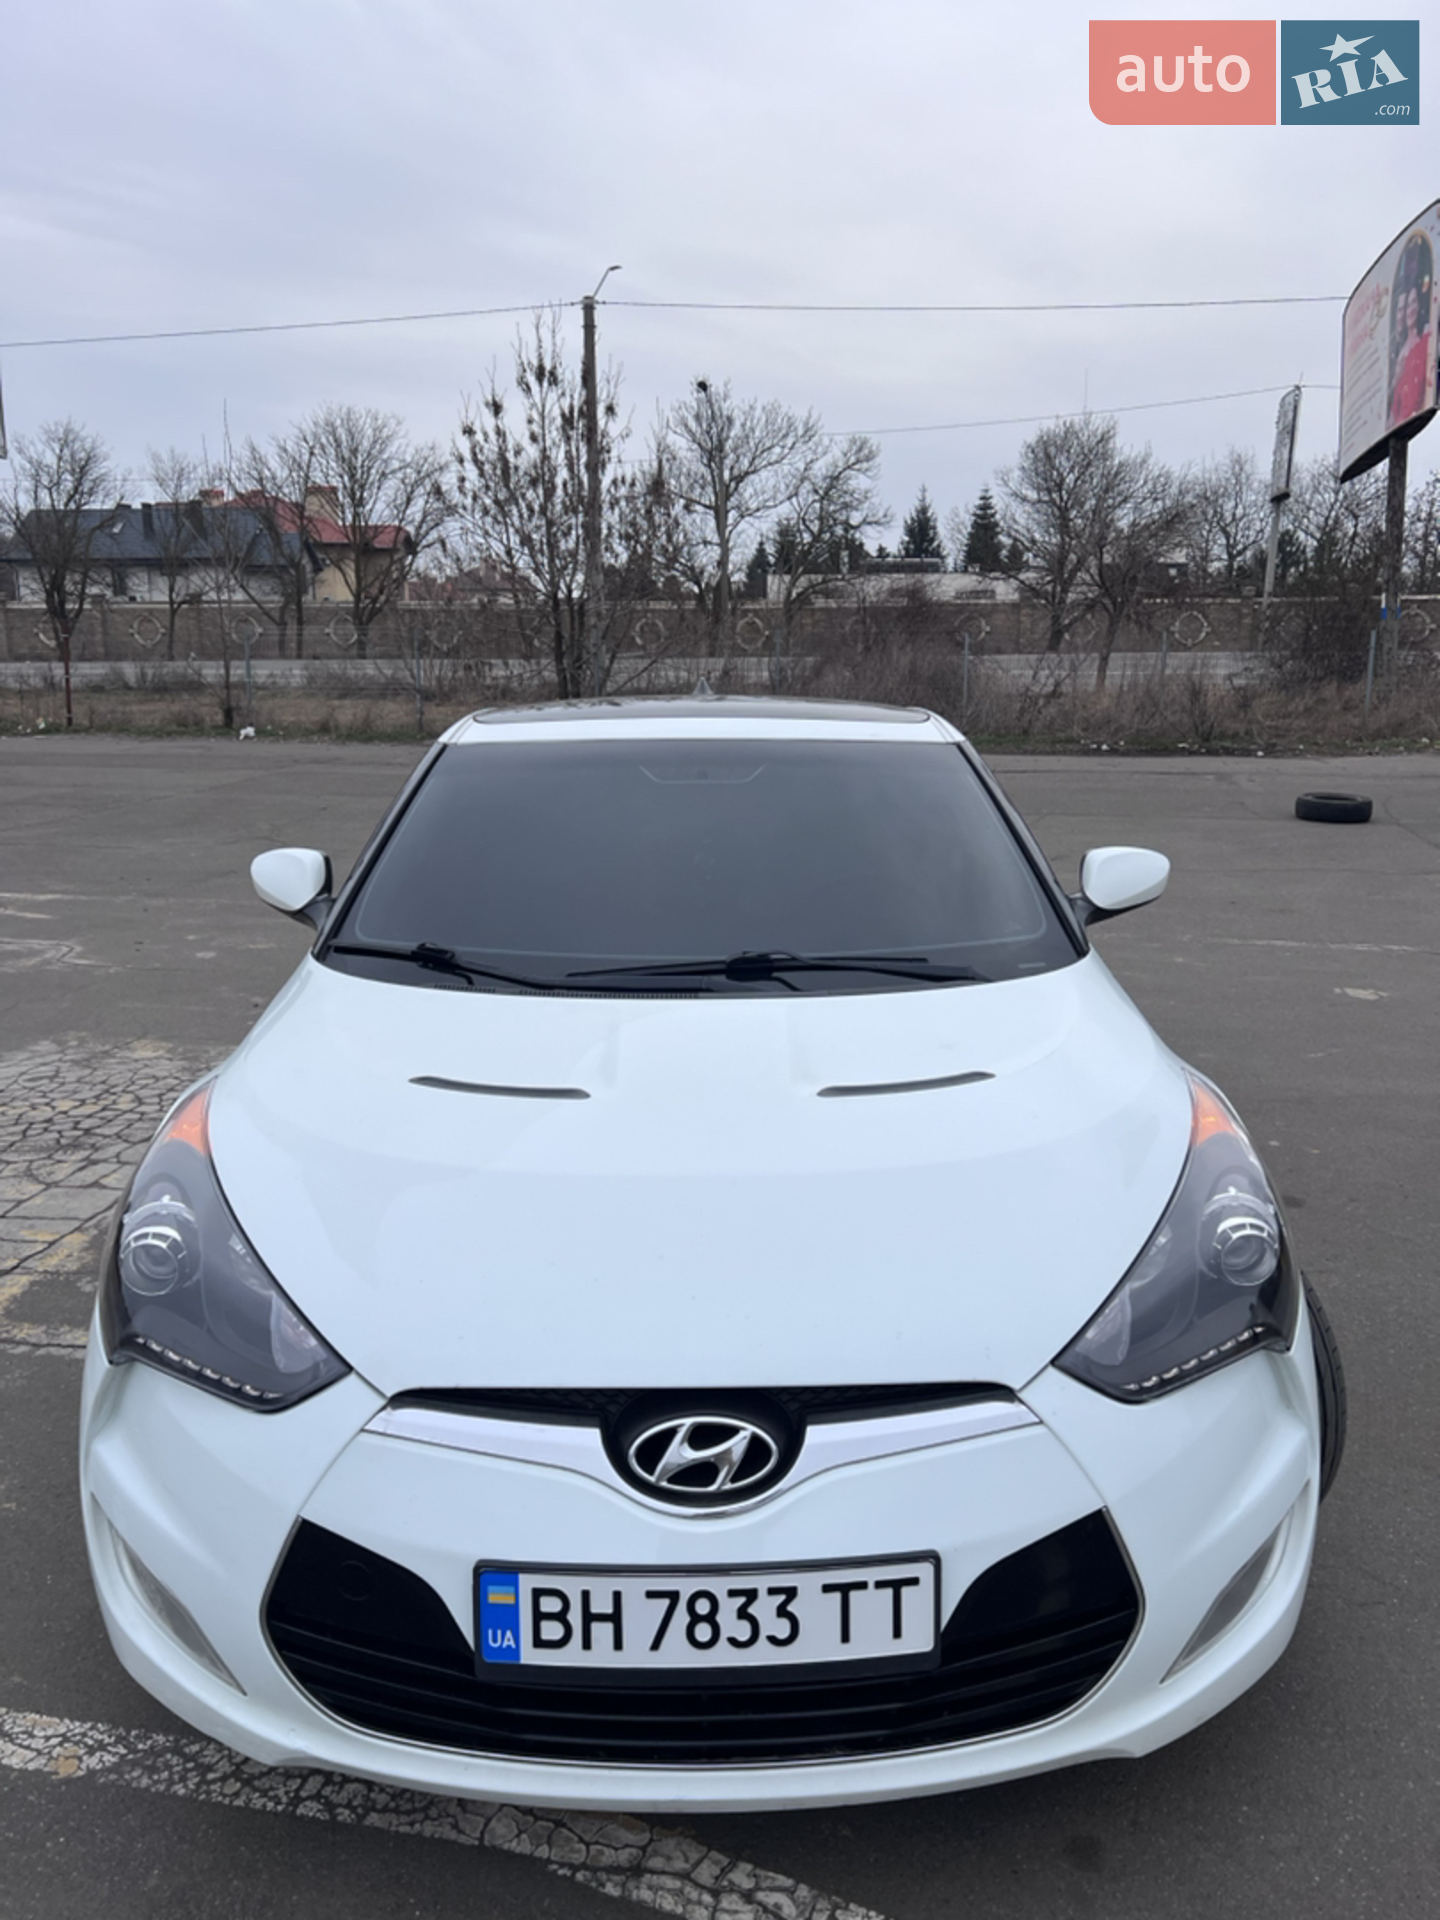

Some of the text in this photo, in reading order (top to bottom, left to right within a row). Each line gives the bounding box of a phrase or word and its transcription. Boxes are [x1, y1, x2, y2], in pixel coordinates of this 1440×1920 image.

[531, 1577, 921, 1652] BH 7833 TT
[488, 1629, 516, 1649] UA
